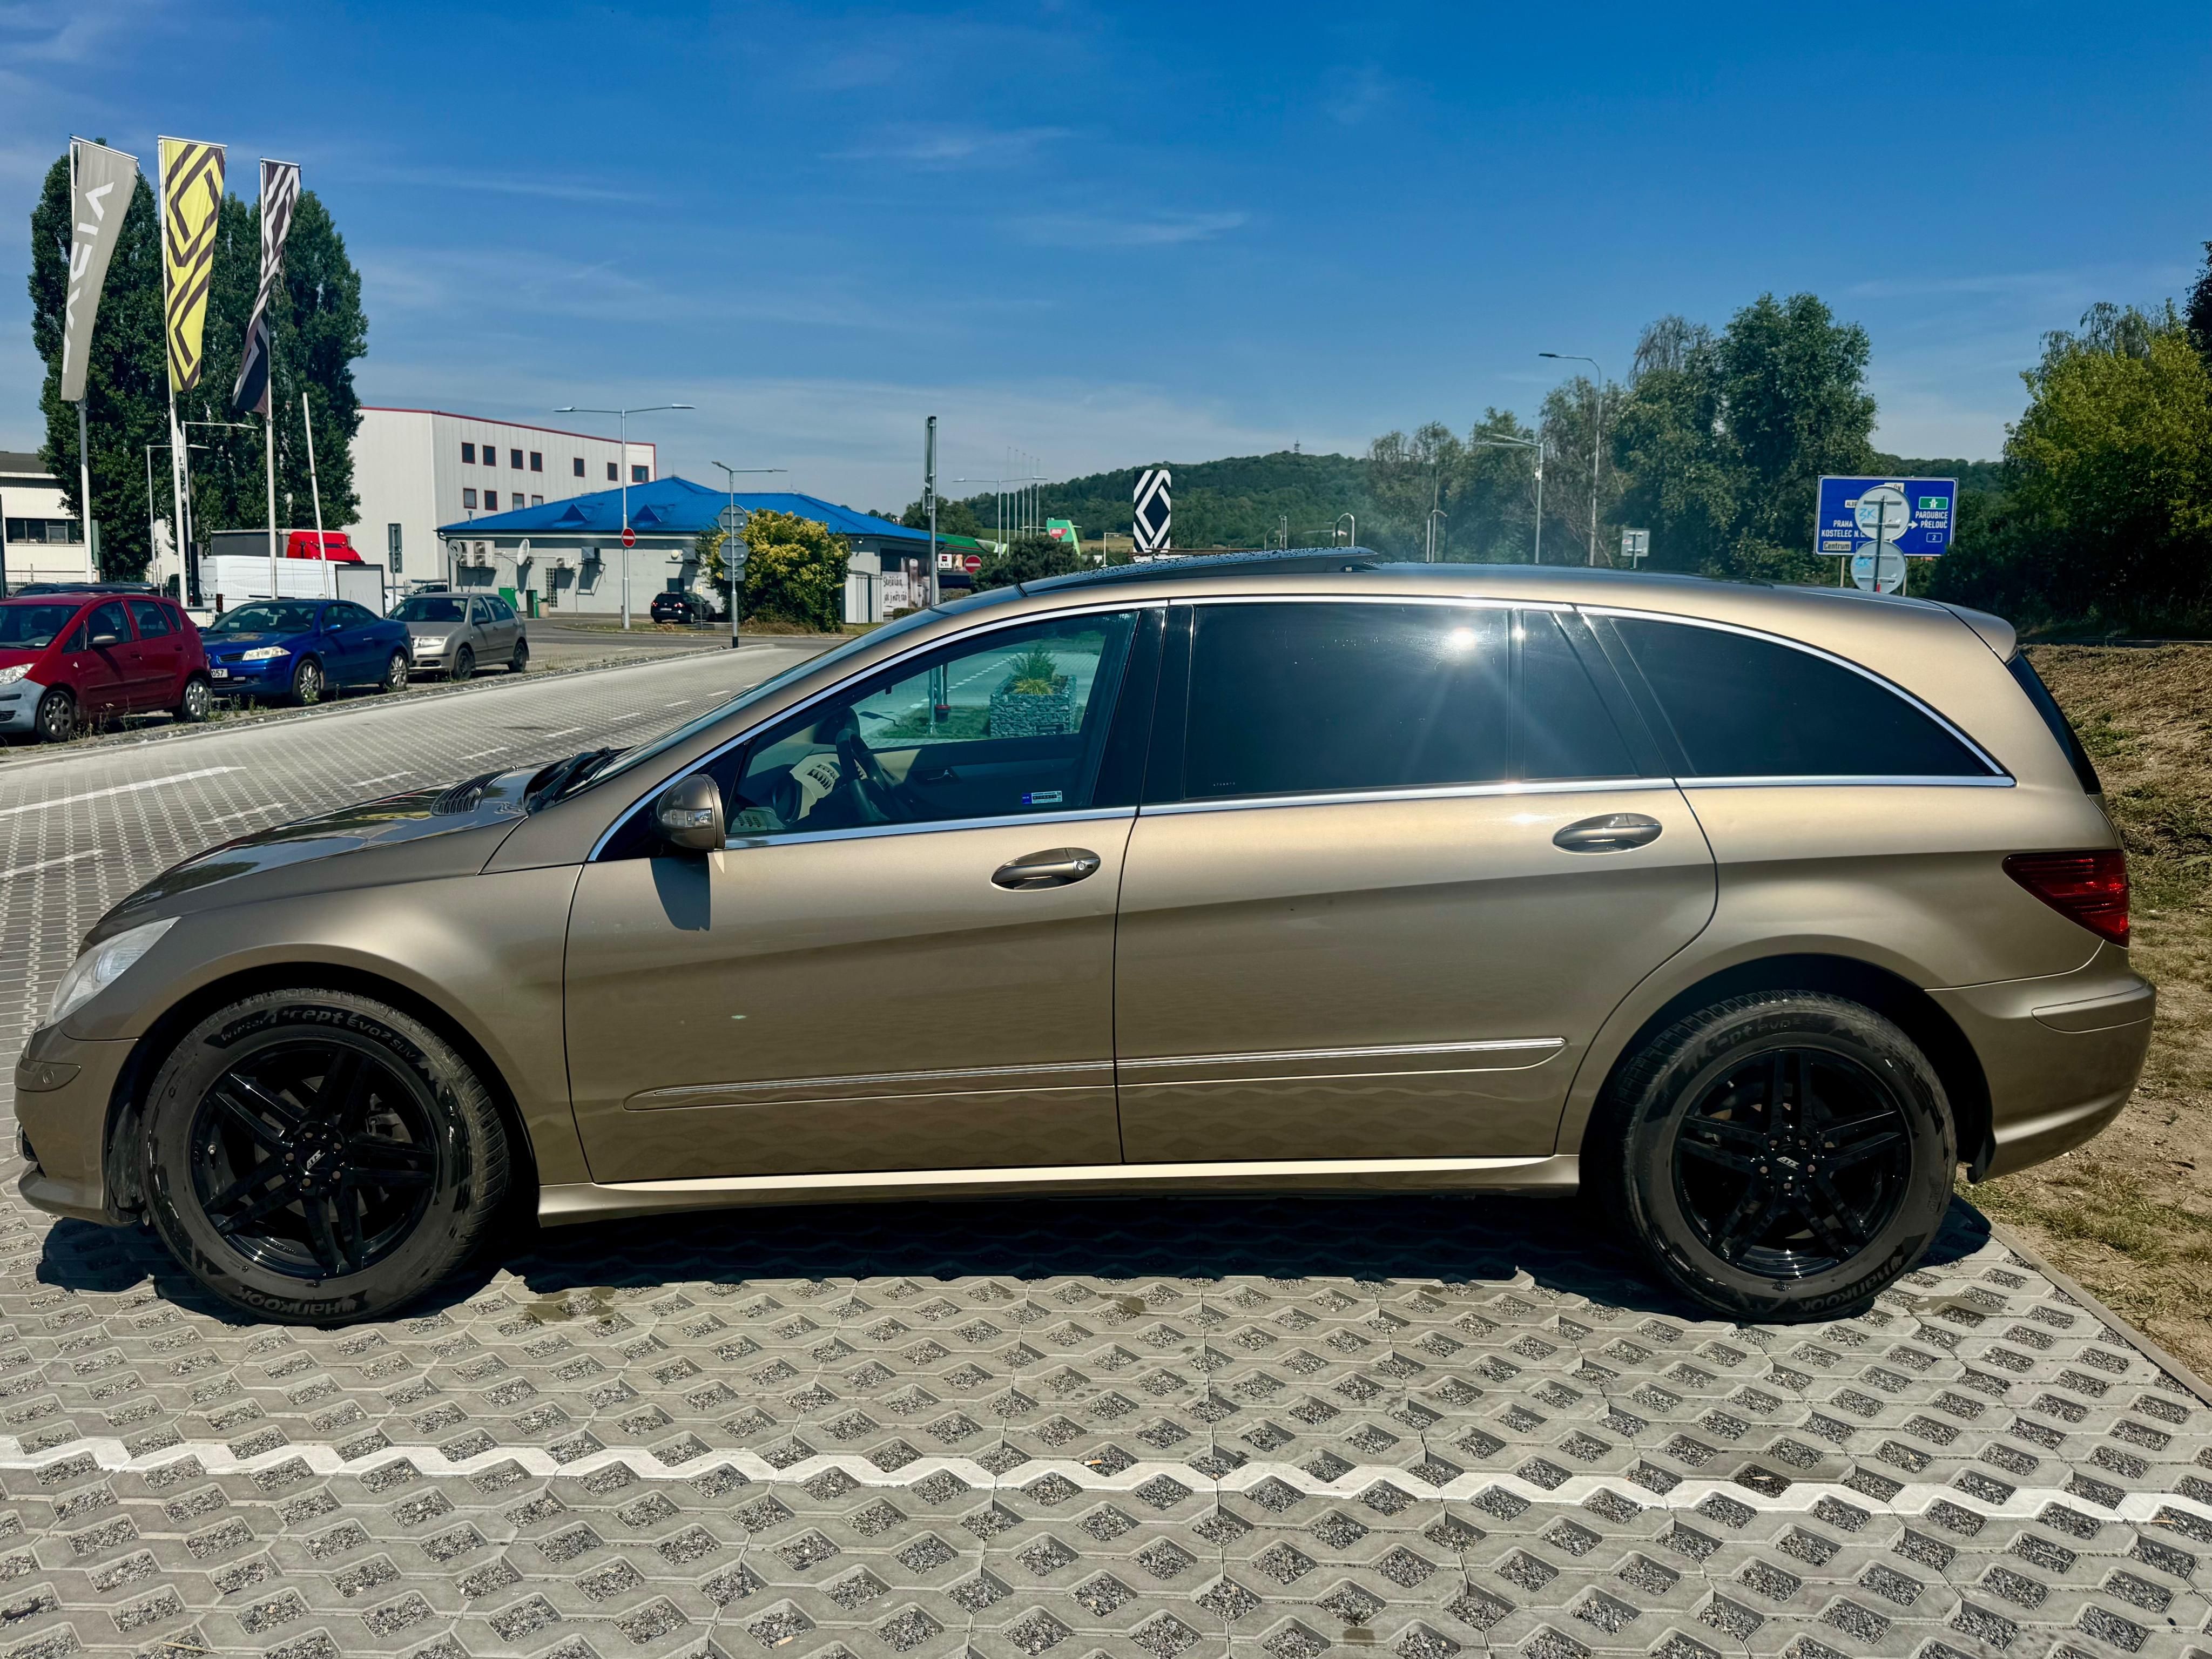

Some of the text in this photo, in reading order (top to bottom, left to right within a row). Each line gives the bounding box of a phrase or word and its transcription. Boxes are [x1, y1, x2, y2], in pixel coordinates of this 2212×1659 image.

[1915, 511, 1948, 519] PARDUBICE
[1920, 519, 1947, 529] PŘELOUČ
[1822, 529, 1853, 537] KOSTELEC
